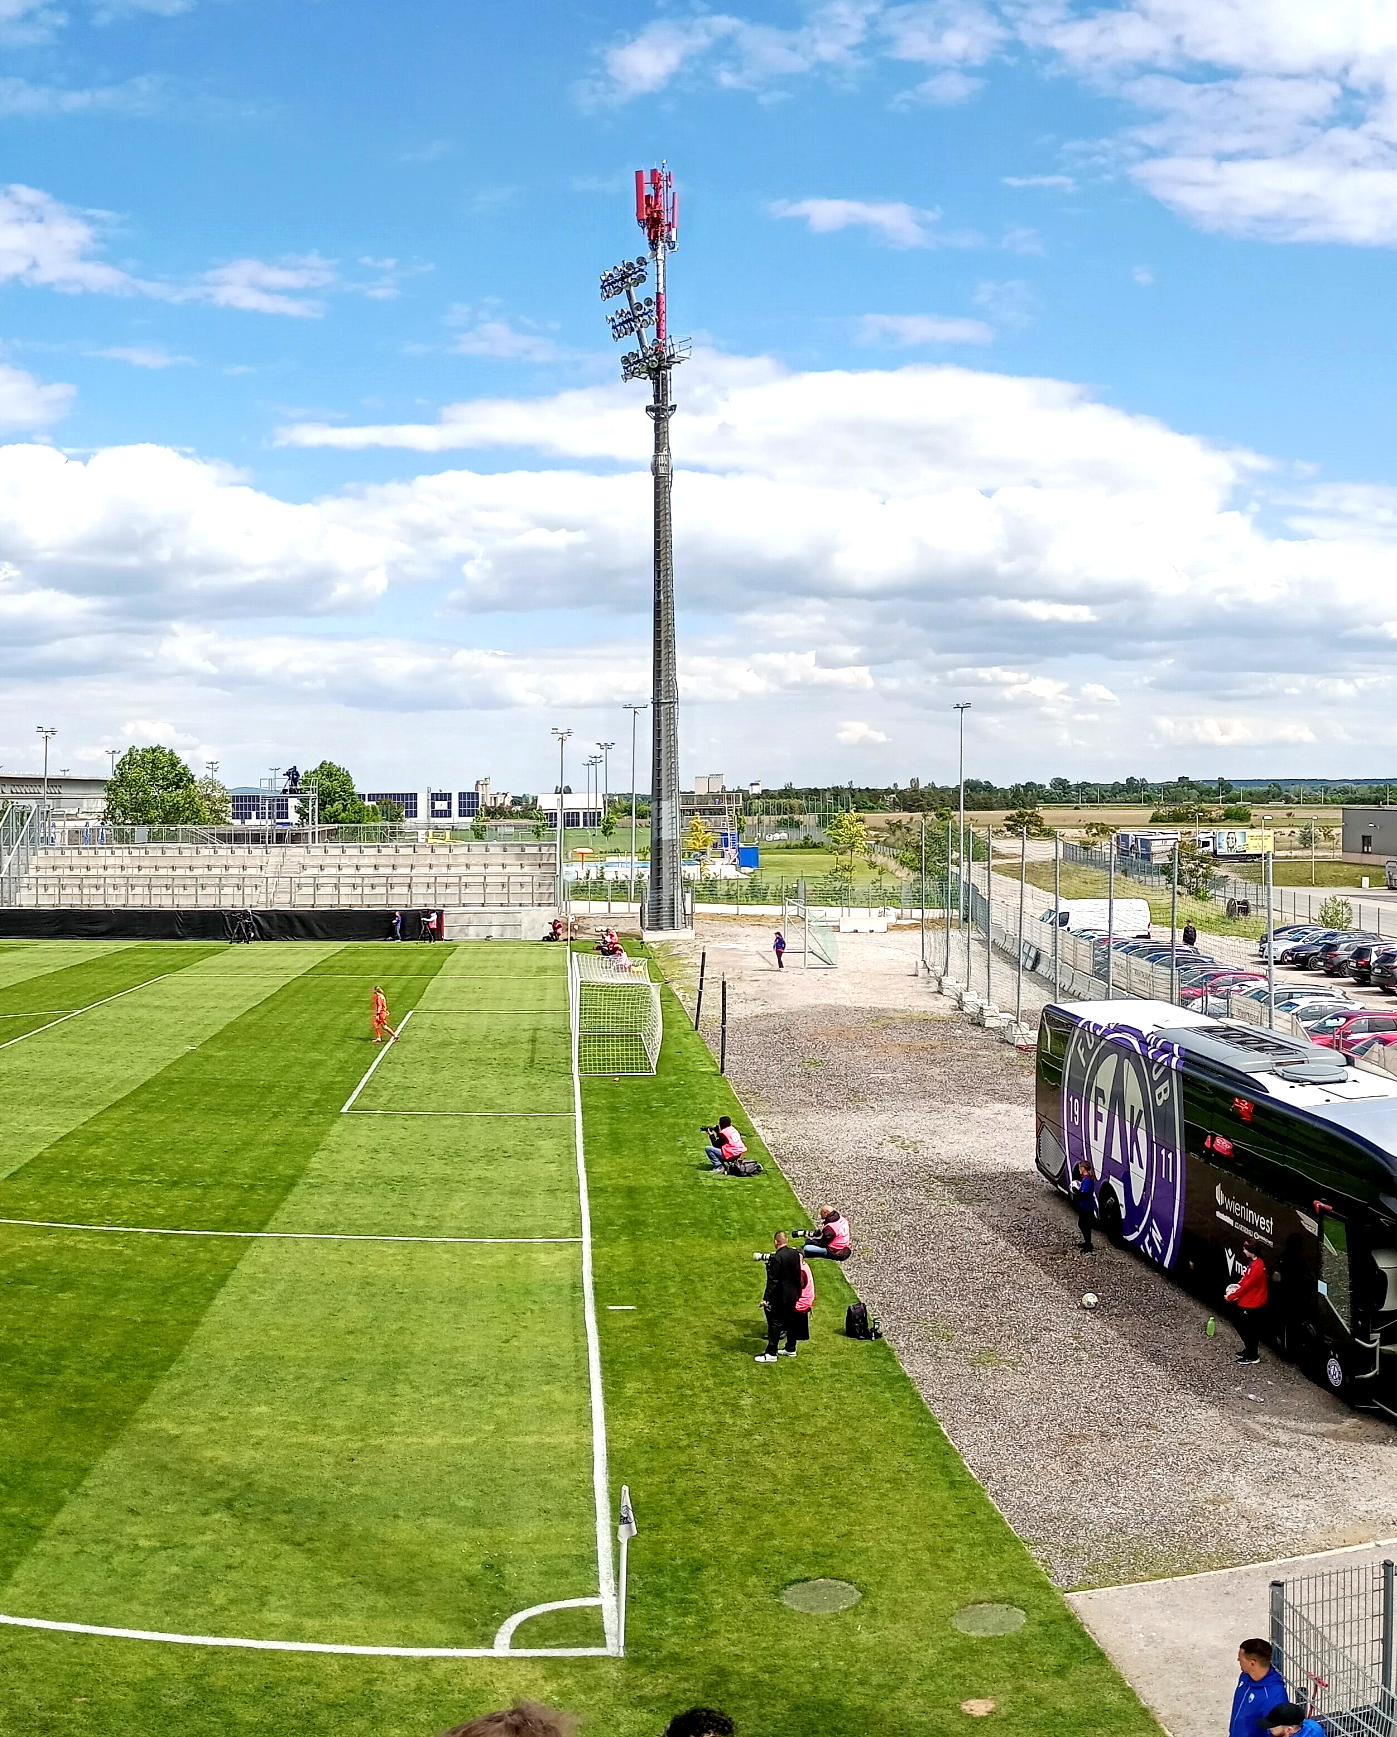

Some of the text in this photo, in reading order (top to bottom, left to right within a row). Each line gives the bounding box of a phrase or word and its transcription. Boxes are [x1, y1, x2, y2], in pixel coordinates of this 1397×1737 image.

[1069, 1094, 1080, 1126] 19
[1160, 1149, 1173, 1182] 11
[1224, 1195, 1274, 1236] wieninvest
